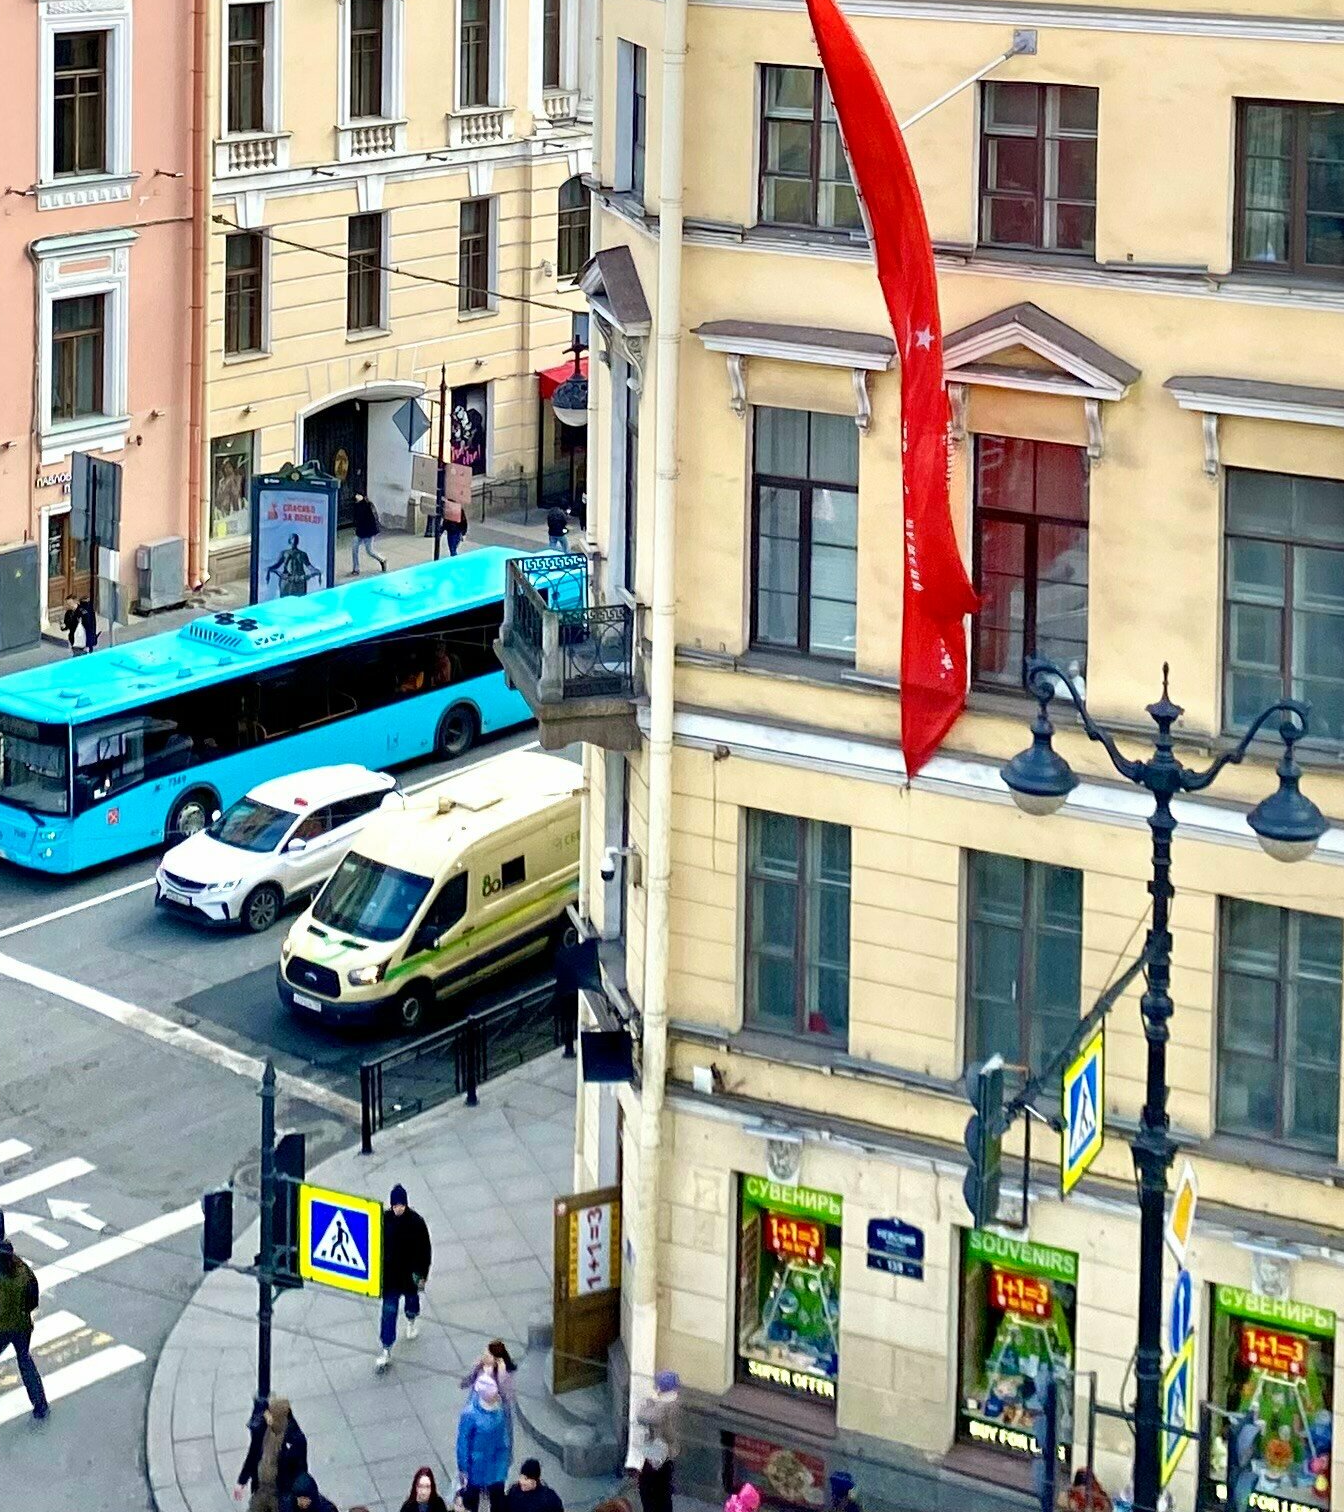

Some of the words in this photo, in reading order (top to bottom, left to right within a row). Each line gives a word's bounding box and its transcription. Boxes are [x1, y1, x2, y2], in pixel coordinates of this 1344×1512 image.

[586, 1207, 602, 1289] 1+1=3
[770, 1217, 820, 1248] 1+1=3
[971, 1231, 1075, 1275] SOUVENIRS
[996, 1274, 1048, 1305] 1+1=3
[1220, 1287, 1335, 1329] СУВЕНИРЫ
[1246, 1331, 1304, 1362] 1+1=3
